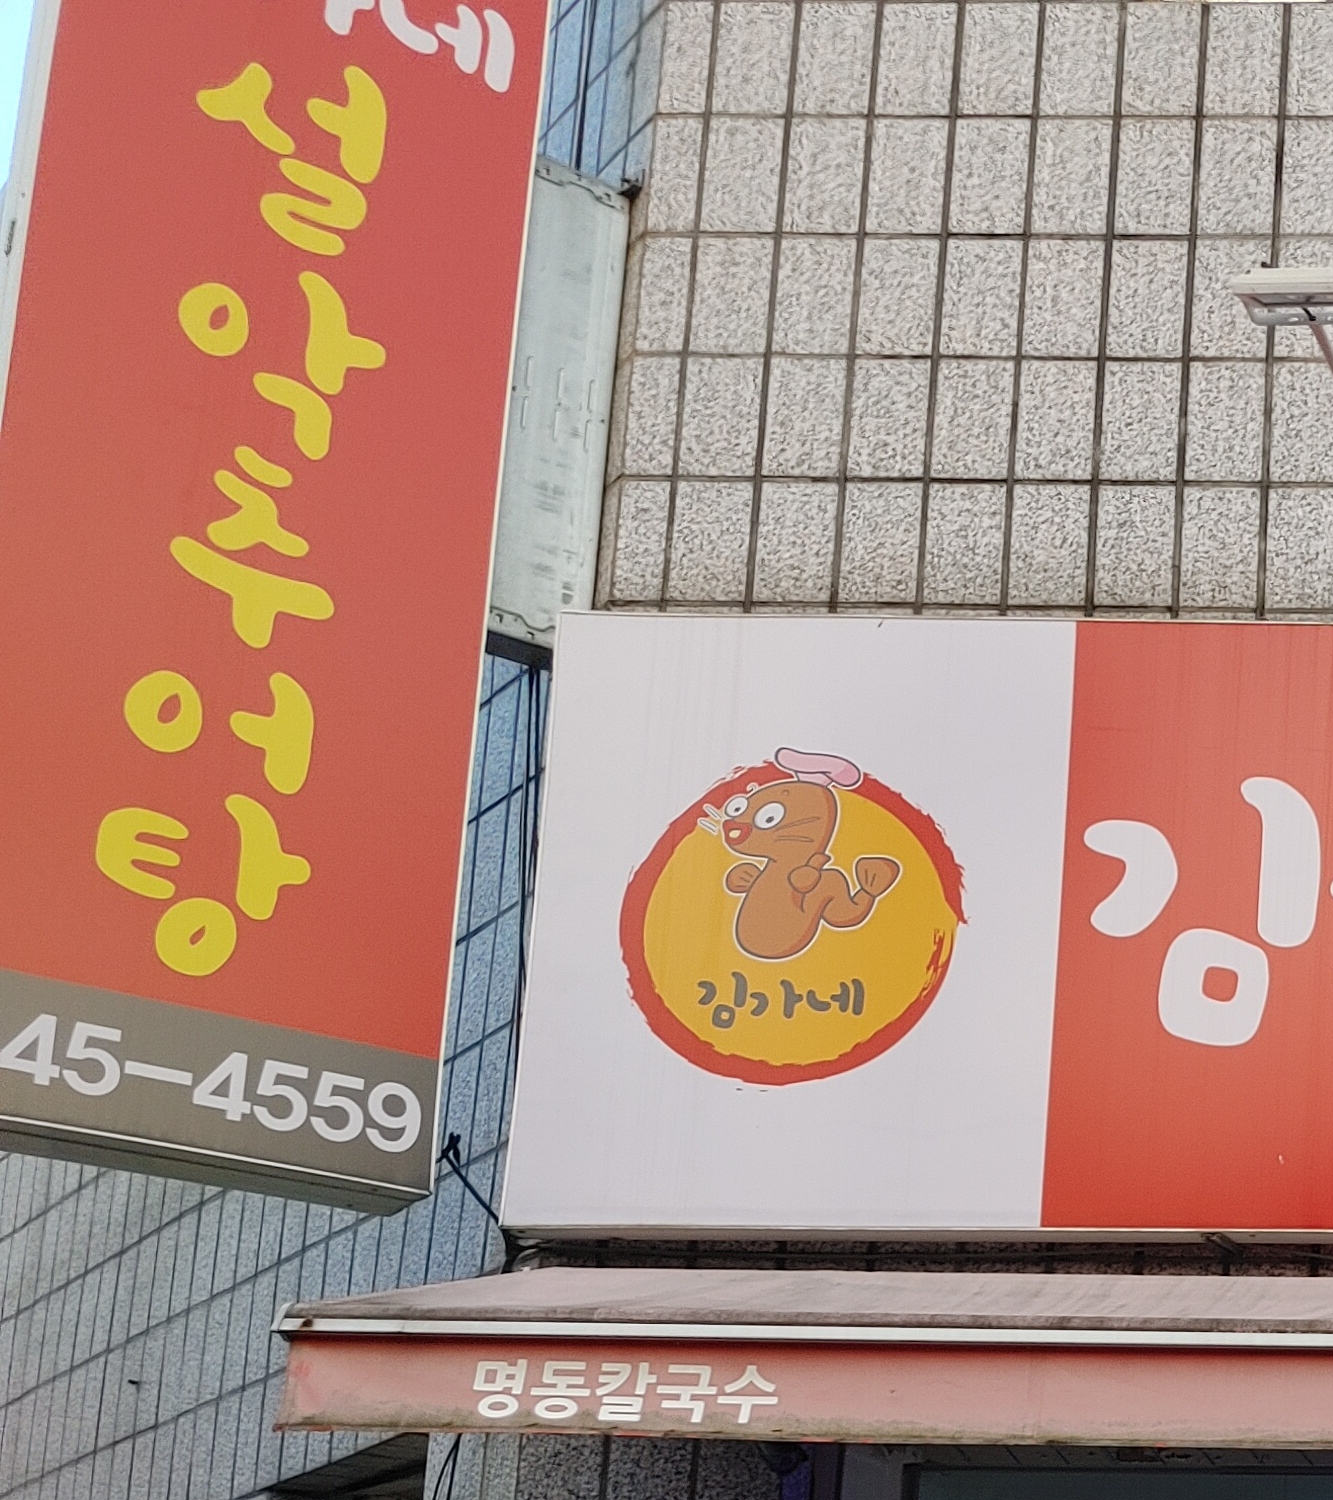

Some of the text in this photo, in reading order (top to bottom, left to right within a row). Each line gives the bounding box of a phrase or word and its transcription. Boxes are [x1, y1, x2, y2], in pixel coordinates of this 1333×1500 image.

[95, 62, 387, 977] 설악추어탕
[696, 971, 866, 1029] 김가네
[472, 1358, 779, 1424] 명동칼국수
